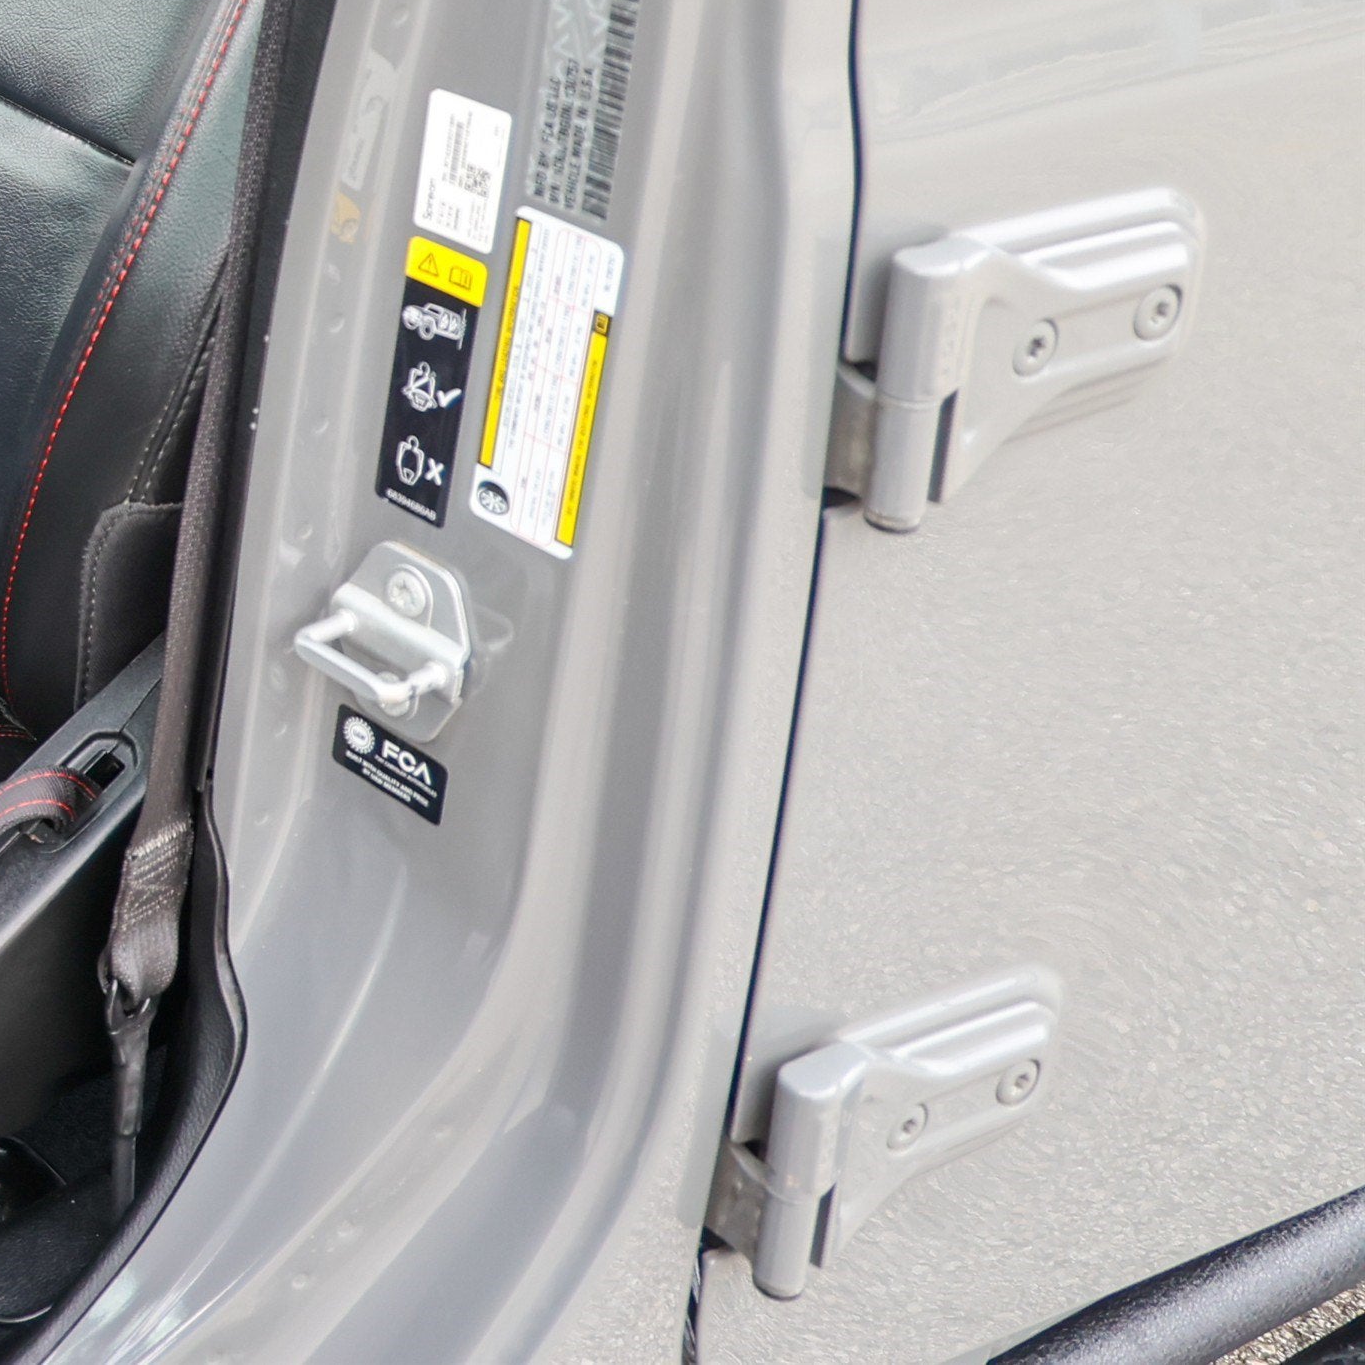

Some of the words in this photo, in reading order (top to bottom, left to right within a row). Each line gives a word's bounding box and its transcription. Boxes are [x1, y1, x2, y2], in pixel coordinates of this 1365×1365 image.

[577, 105, 588, 120] IN
[572, 125, 586, 158] MADE
[565, 162, 579, 209] VEHICLE
[382, 738, 431, 785] FCA
